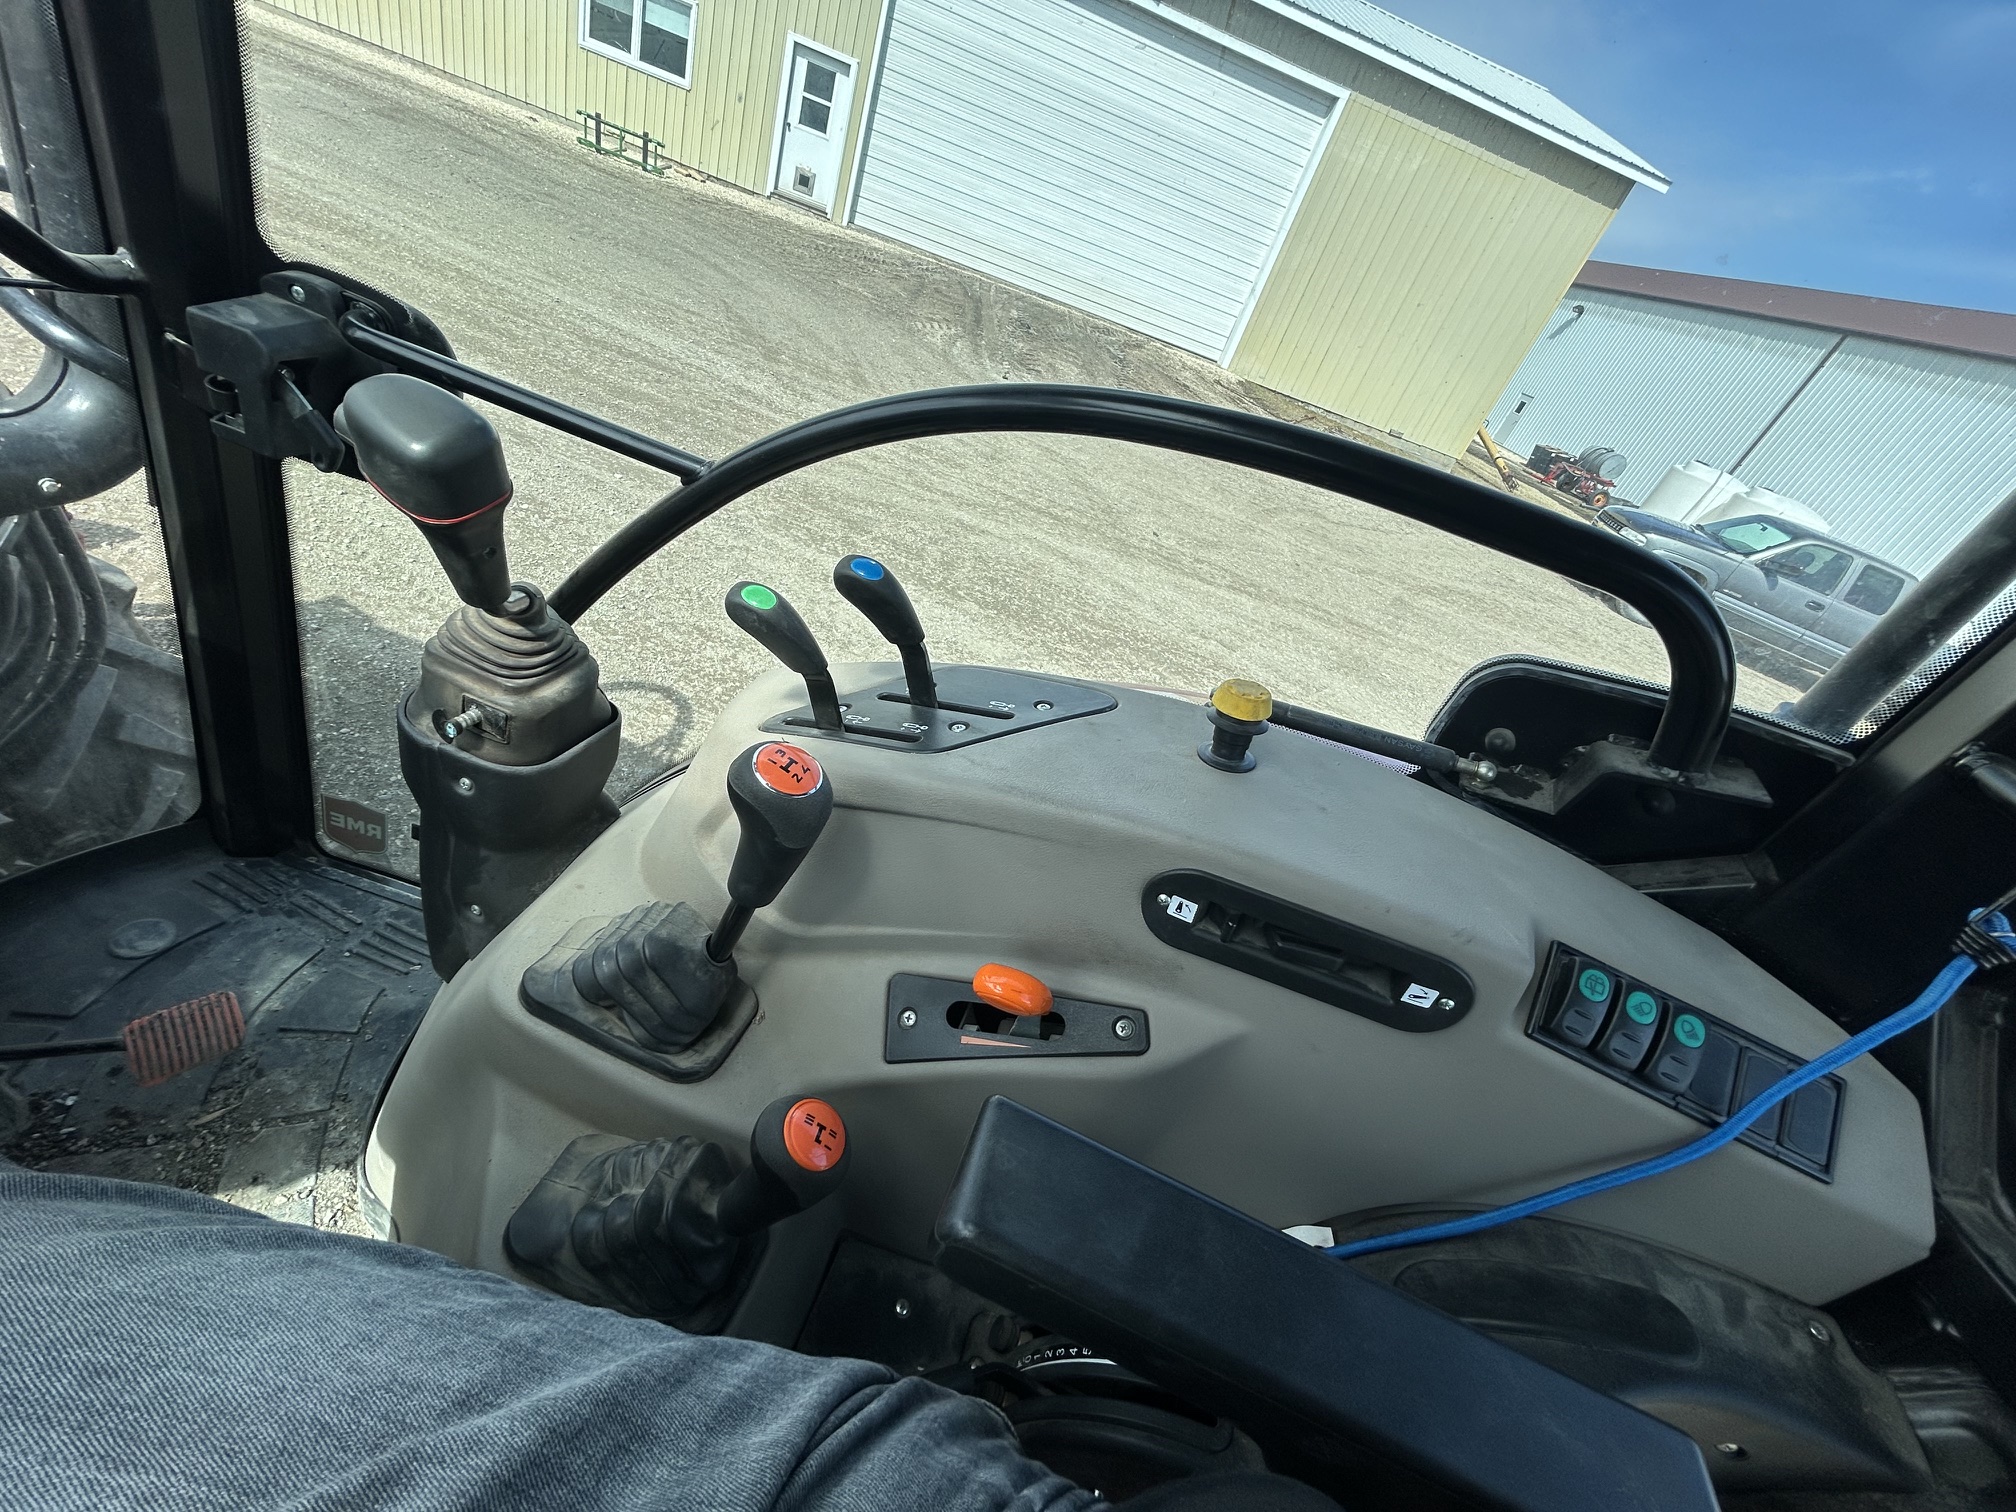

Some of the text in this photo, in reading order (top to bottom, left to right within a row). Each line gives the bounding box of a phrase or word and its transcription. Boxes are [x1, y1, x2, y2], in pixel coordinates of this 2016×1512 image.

[775, 748, 786, 758] 3
[791, 773, 803, 784] 2
[1044, 1350, 1053, 1358] 2
[1056, 1348, 1065, 1356] 3
[1069, 1347, 1078, 1356] 4
[1082, 1347, 1092, 1355] 5
